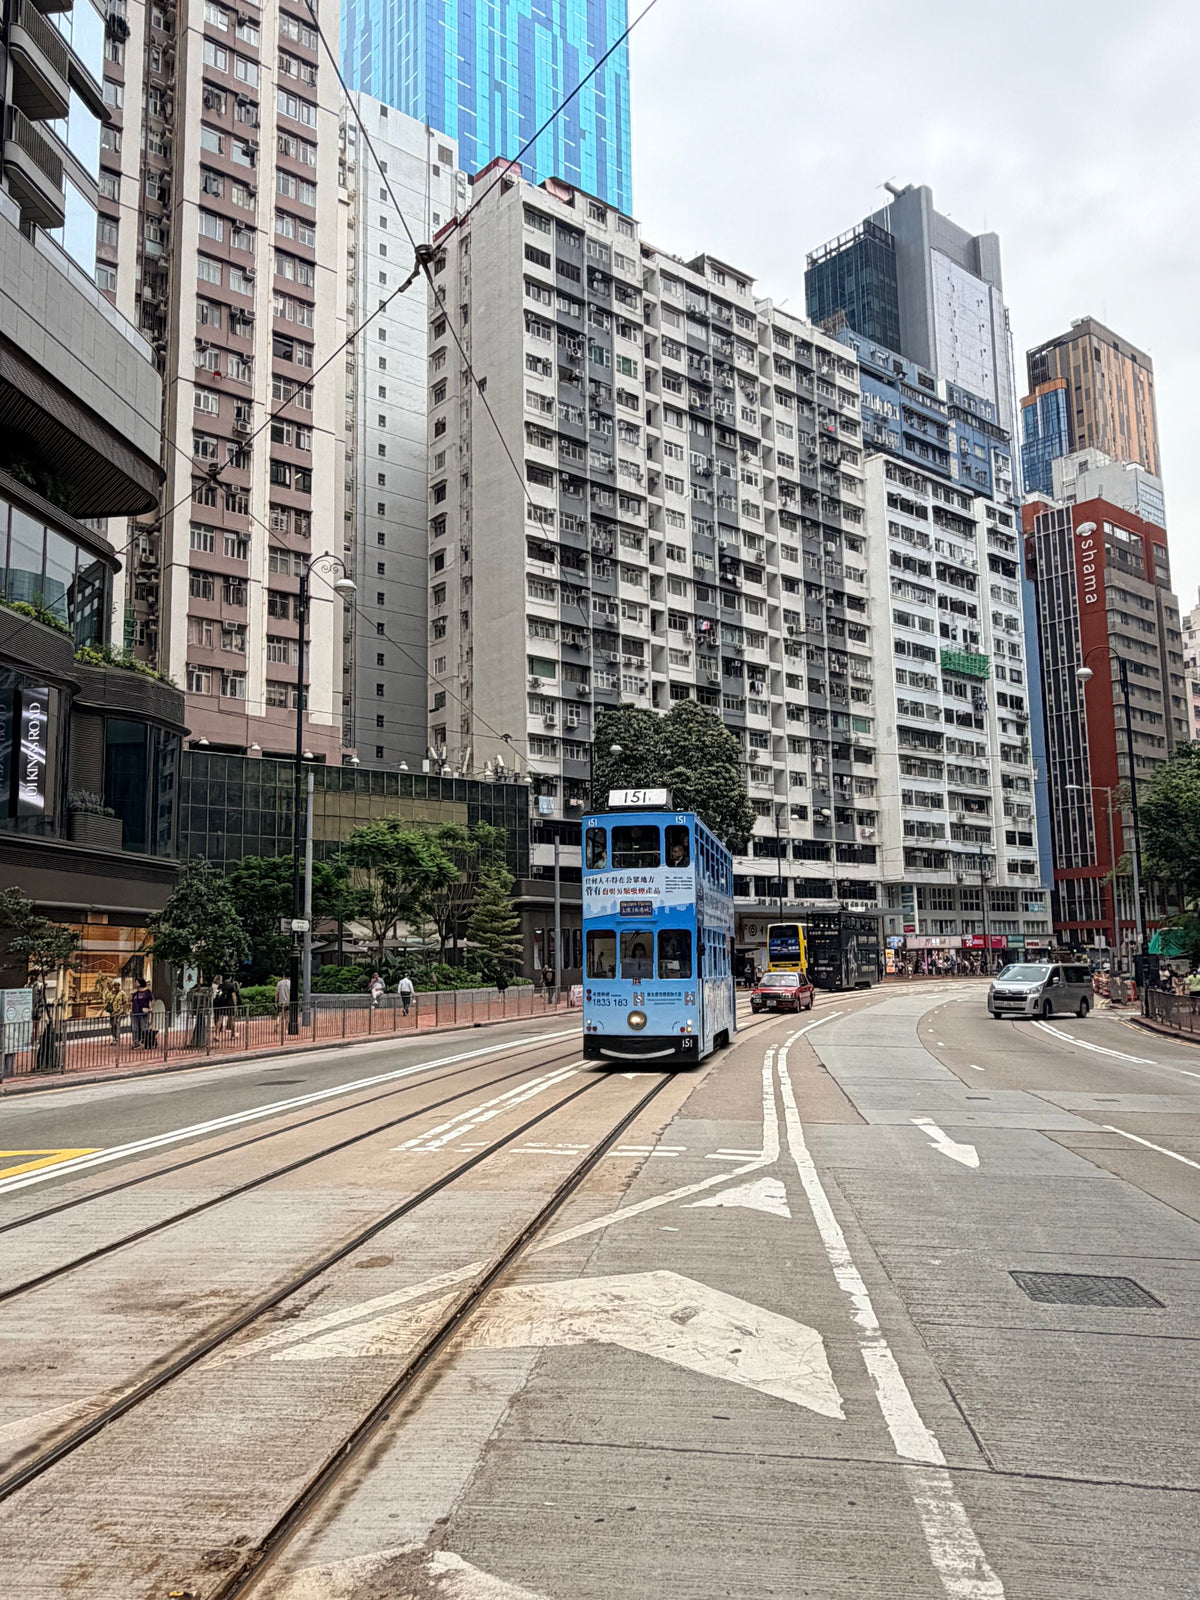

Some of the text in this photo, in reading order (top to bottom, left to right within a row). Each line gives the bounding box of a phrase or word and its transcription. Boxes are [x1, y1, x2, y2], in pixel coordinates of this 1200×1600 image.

[1081, 539, 1098, 604] shama
[28, 702, 41, 740] ROAD
[25, 783, 38, 799] 101
[624, 790, 647, 803] 151
[588, 818, 598, 827] 151
[675, 815, 686, 824] 151
[593, 998, 628, 1007] 1833 183
[682, 1038, 693, 1048] 151
